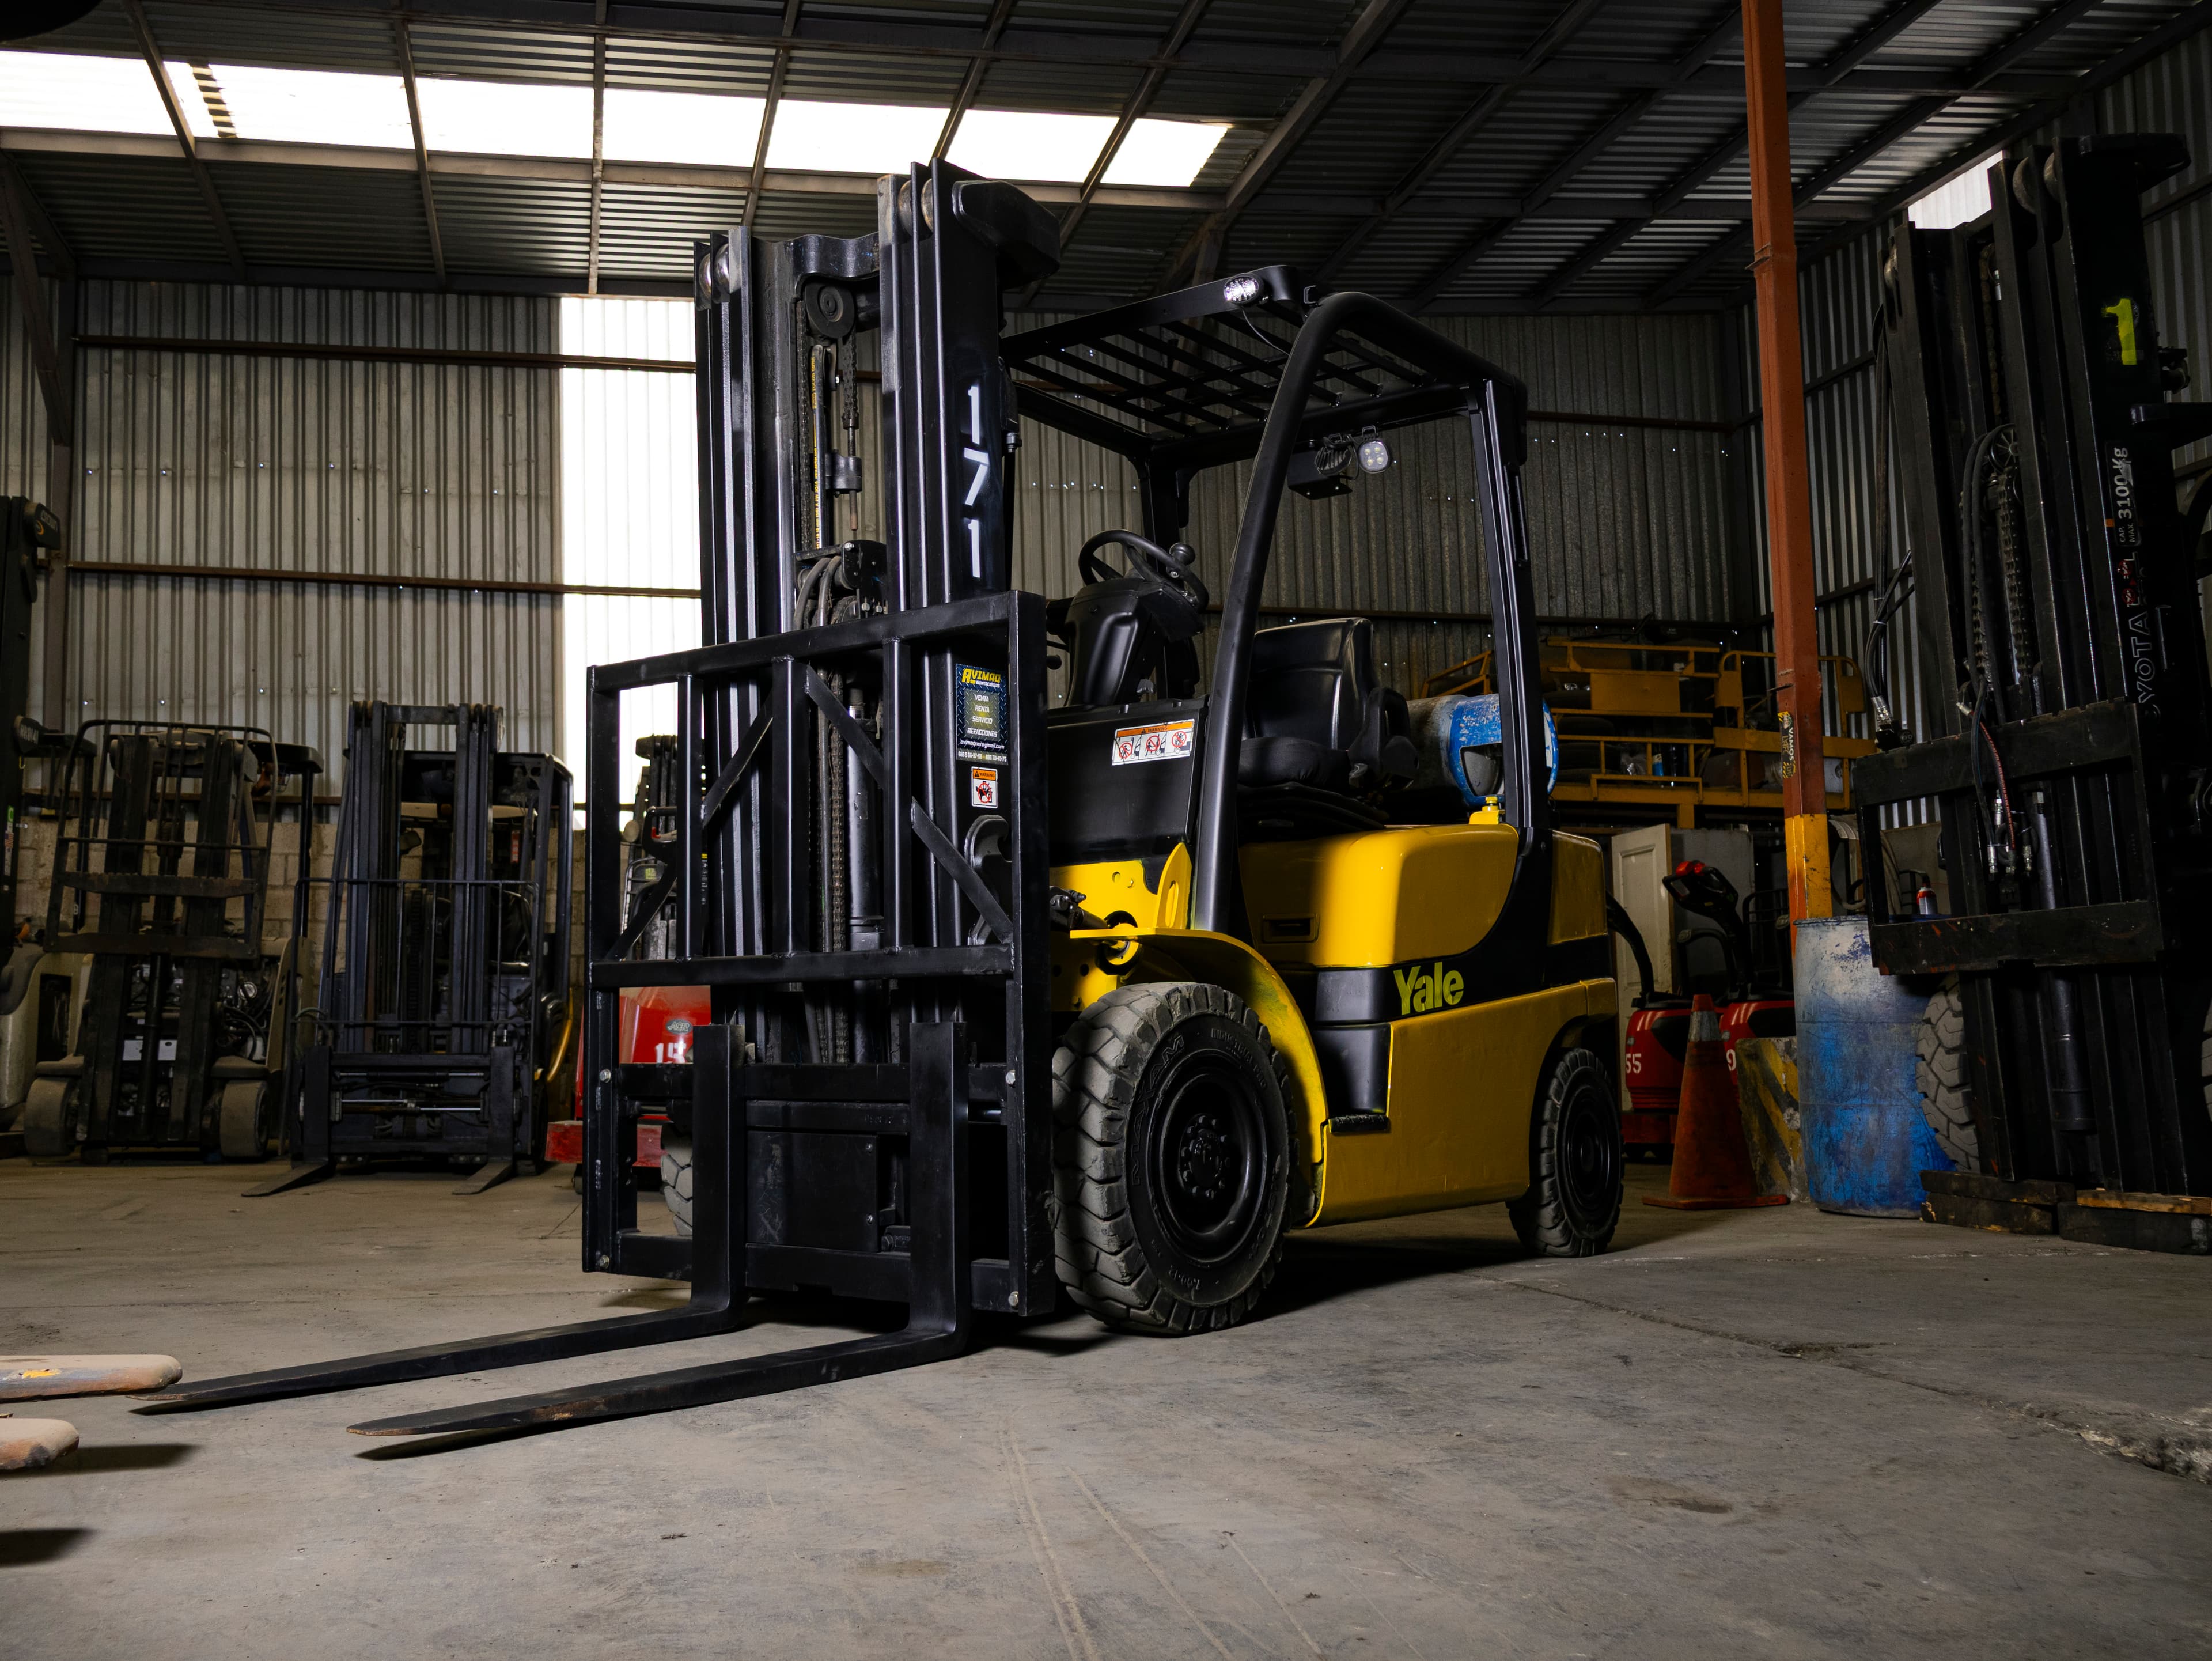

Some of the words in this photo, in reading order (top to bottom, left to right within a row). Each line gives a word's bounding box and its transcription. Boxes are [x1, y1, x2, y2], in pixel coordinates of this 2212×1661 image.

[2113, 475, 2132, 519] 3100
[2127, 522, 2136, 543] MAX.
[961, 668, 1001, 684] AVIMAQ
[975, 694, 989, 702] VENTA
[975, 705, 990, 713] RENTA
[972, 716, 993, 724] SERVICIO
[967, 727, 998, 737] REFACCIONES
[1393, 961, 1464, 1016] Yale
[1131, 1035, 1185, 1185] MAXAM
